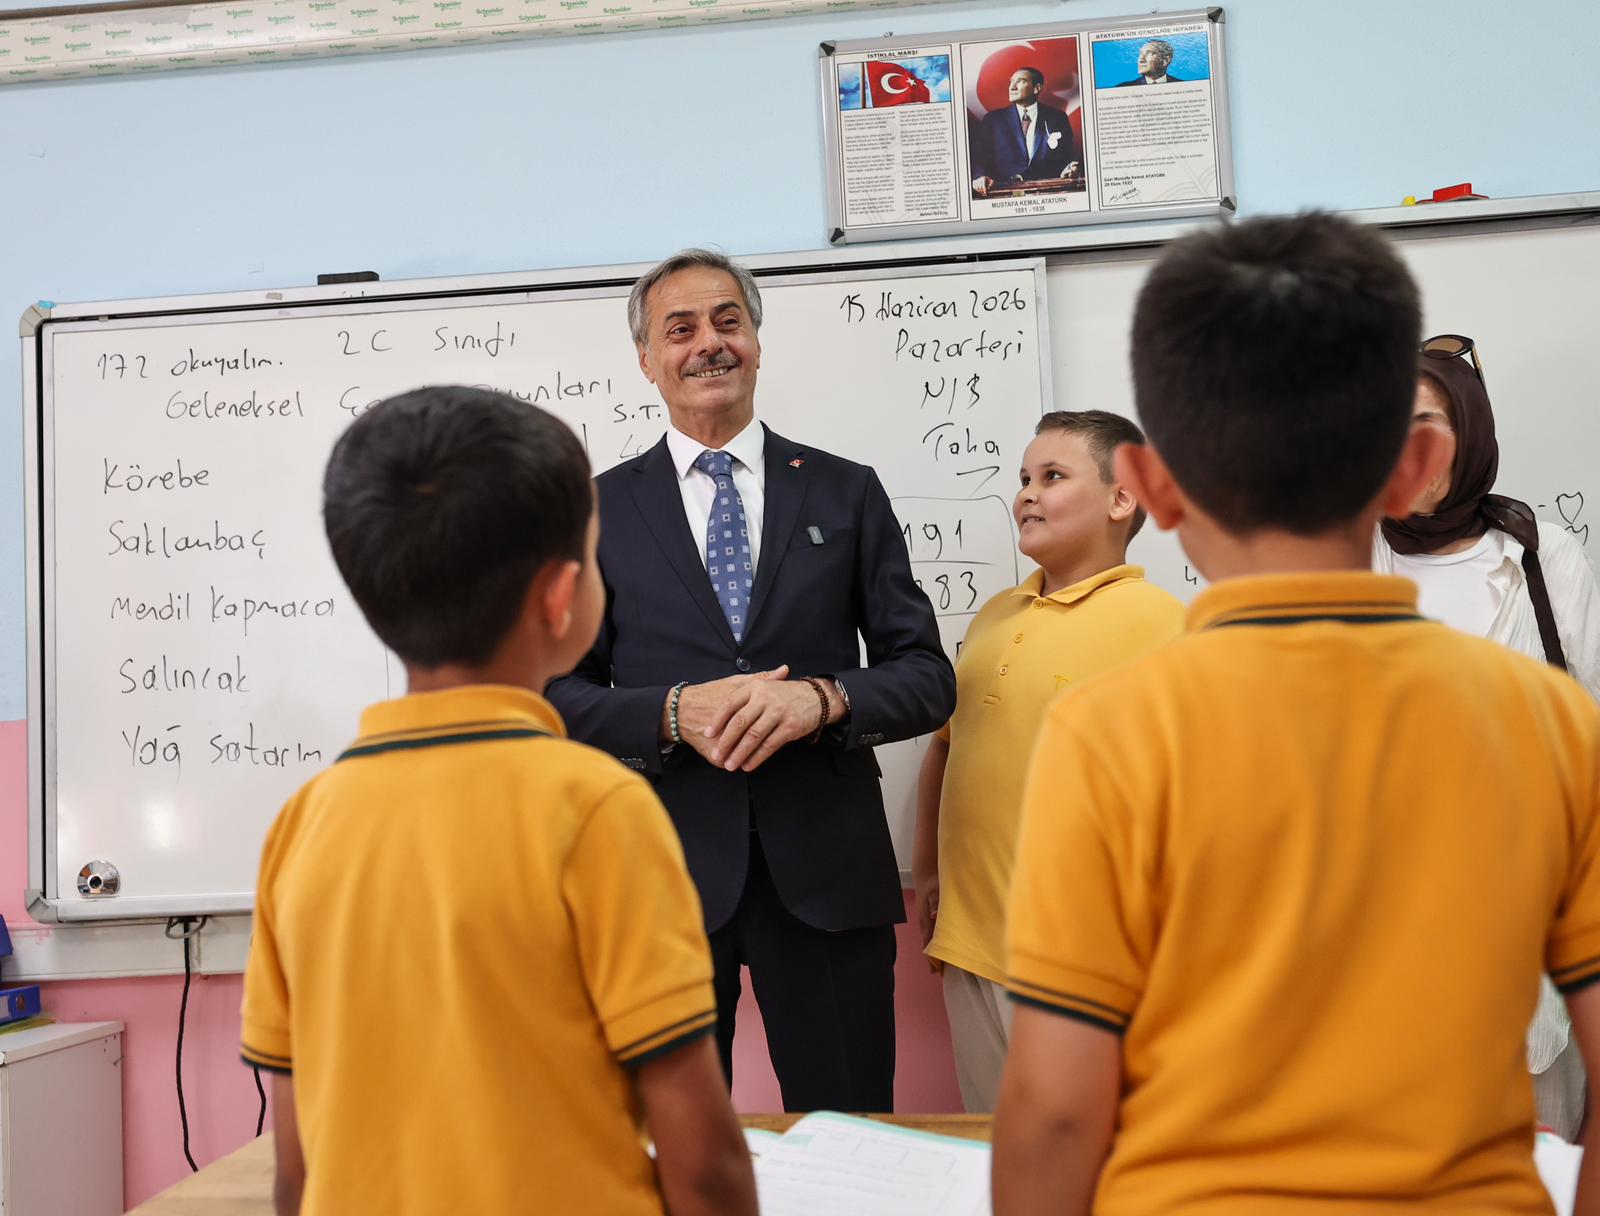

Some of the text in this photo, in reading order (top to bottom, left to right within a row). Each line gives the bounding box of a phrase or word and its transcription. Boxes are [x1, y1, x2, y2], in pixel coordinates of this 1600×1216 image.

[991, 196, 1068, 208] MUSTAFA KEMAL ATATÜRK
[840, 288, 1026, 323] 15 Haziran 2026
[337, 330, 360, 355] 2
[434, 321, 515, 358] Sınıfı
[895, 328, 1024, 362] Pazartesi
[96, 353, 149, 380] 172
[165, 390, 304, 420] Geleneksel
[612, 405, 663, 424] S.T.
[922, 422, 1001, 463] Taha
[104, 457, 209, 494] Körebe
[914, 571, 977, 611] 83
[119, 654, 249, 694] Salıncak
[210, 722, 322, 768] satarım
